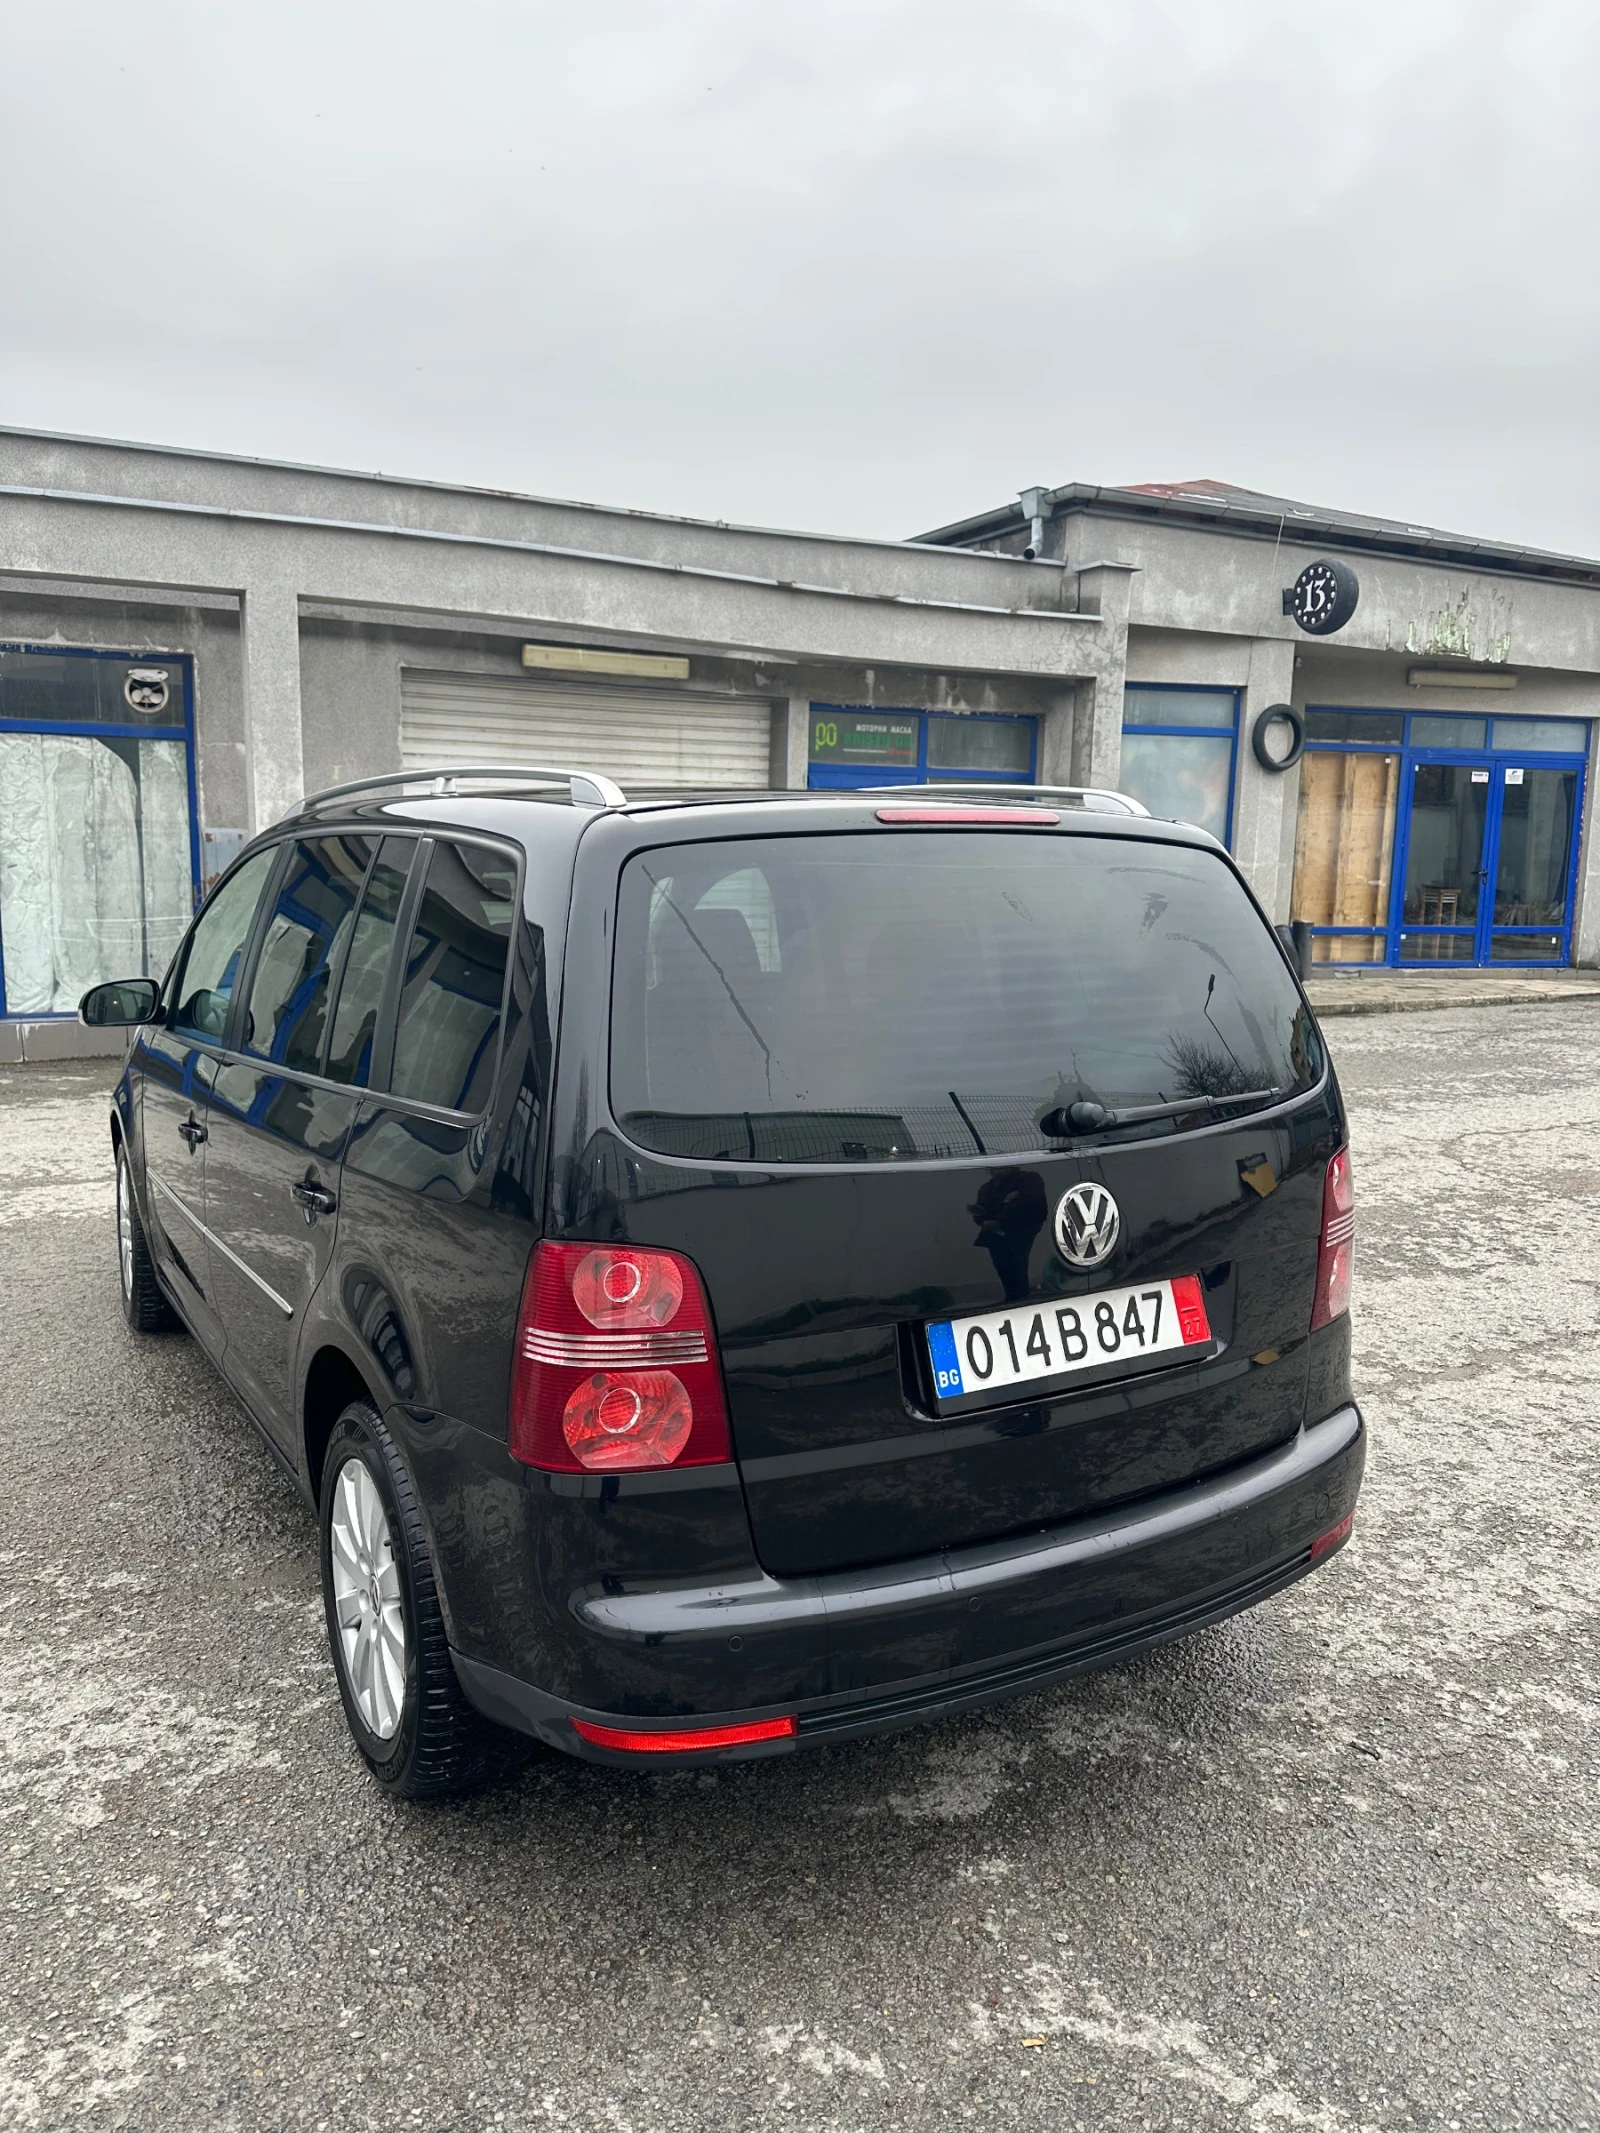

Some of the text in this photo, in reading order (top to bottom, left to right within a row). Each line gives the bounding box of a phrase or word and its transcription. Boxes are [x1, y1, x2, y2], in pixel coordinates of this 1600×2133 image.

[1303, 578, 1326, 613] 13
[966, 1290, 1163, 1379] 014B847
[1184, 1317, 1200, 1336] 27
[938, 1369, 960, 1388] BG
